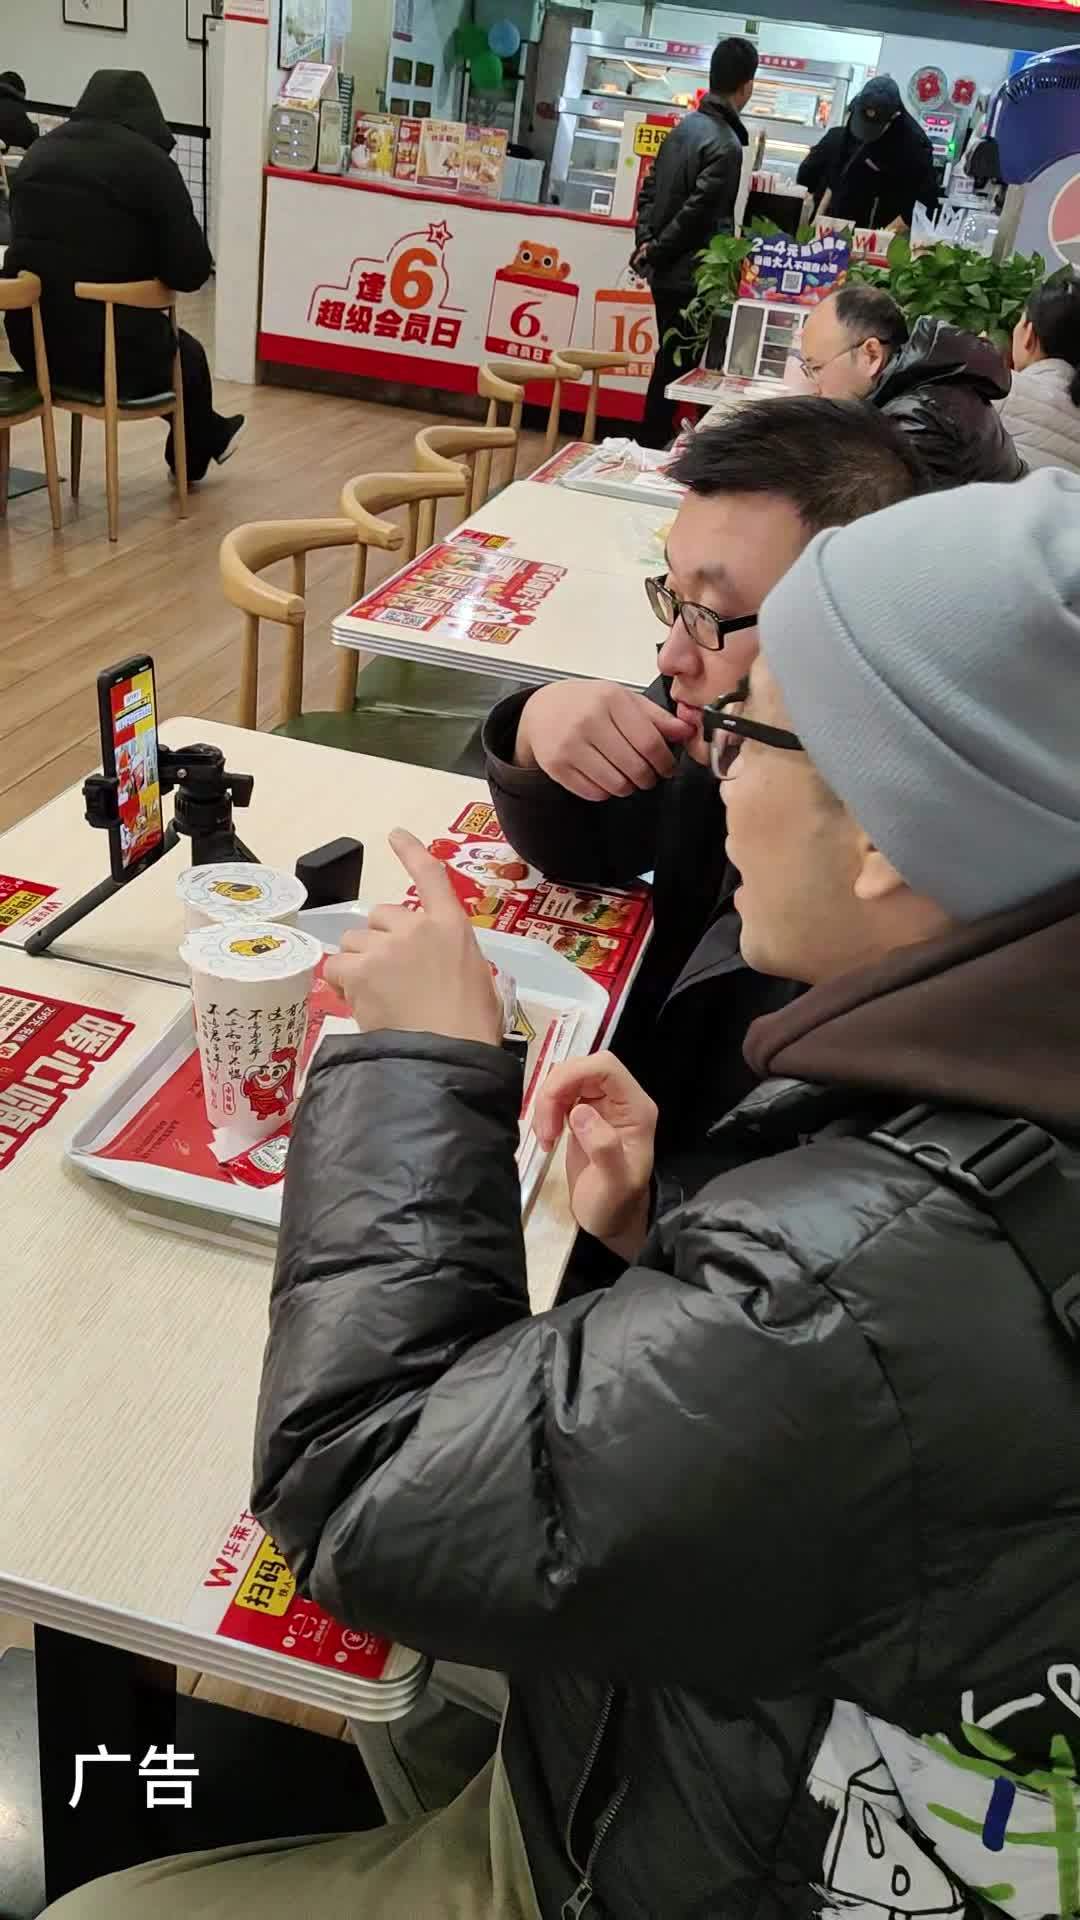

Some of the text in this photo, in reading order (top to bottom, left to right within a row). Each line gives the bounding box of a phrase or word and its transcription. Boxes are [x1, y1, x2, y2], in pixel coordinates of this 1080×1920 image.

[316, 299, 462, 349] 超级会员日
[611, 315, 653, 356] 16
[0, 1013, 127, 1164] 暖心嗨
